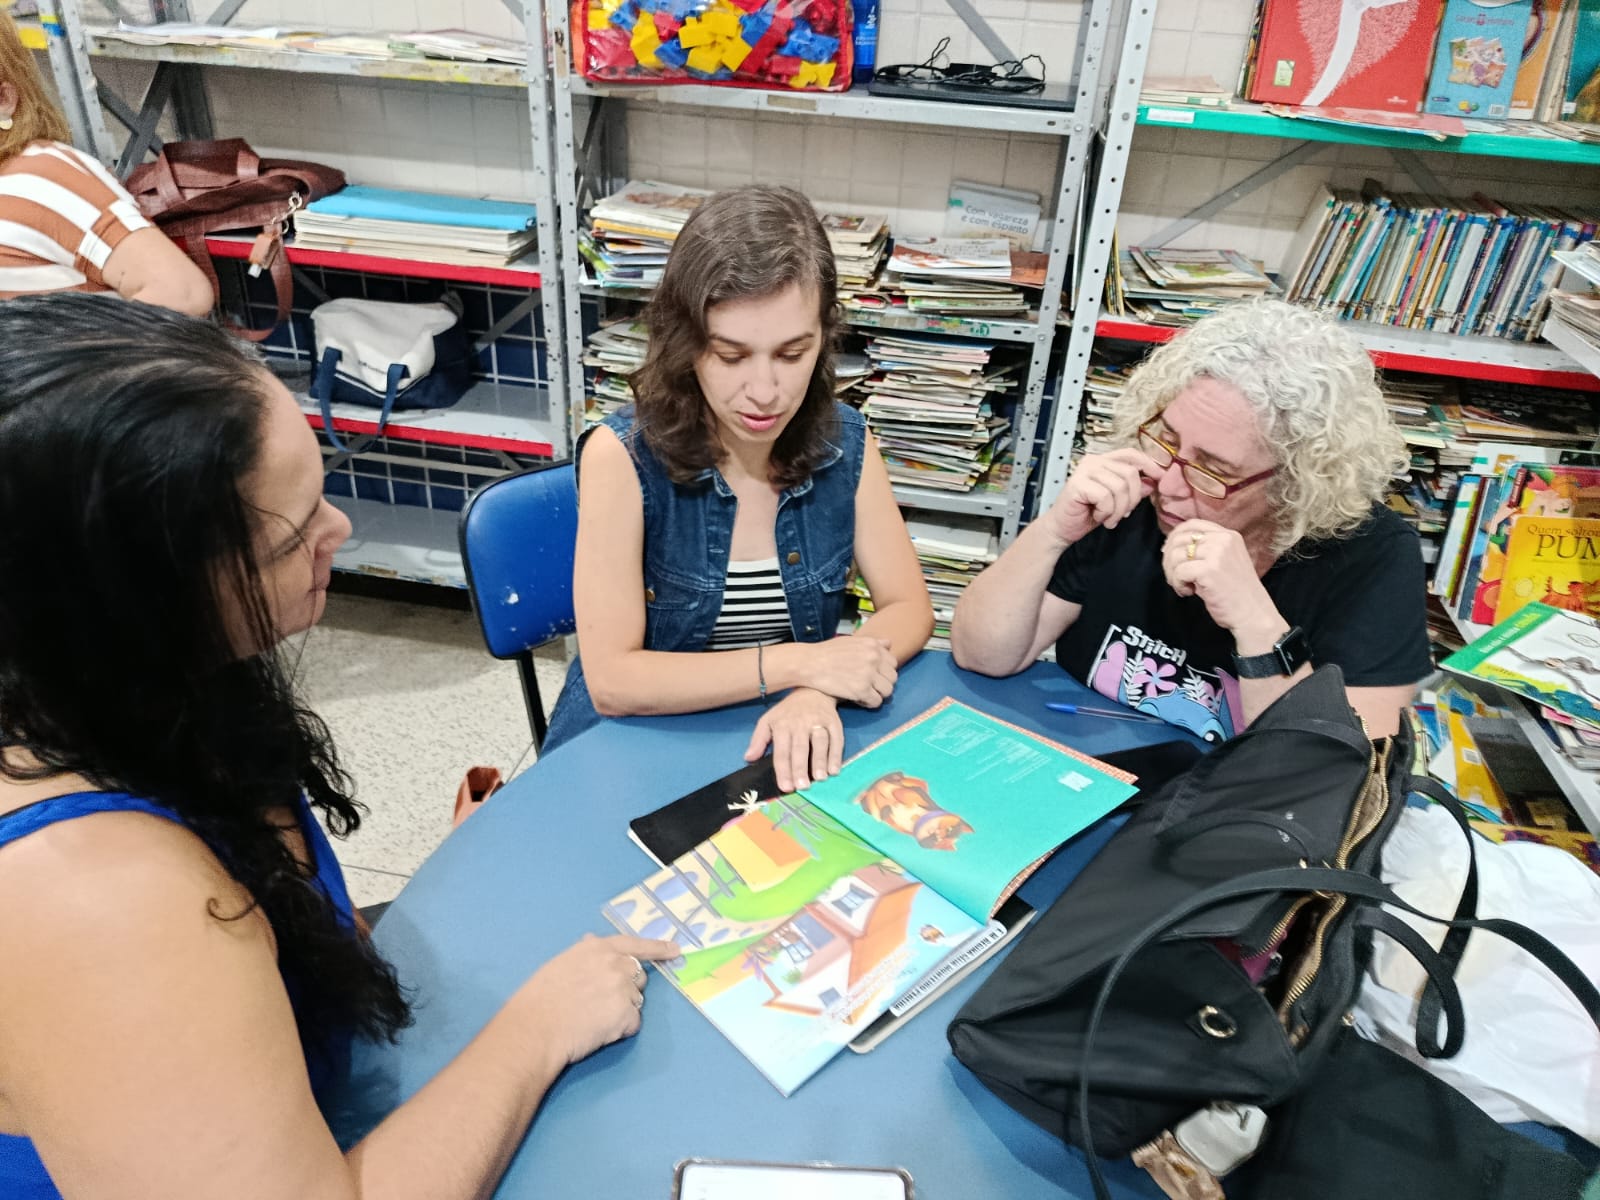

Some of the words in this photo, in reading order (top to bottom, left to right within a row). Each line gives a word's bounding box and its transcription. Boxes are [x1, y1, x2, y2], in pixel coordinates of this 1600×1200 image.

[965, 205, 986, 216] Com
[969, 216, 990, 227] com
[991, 221, 1029, 234] espanto
[1527, 523, 1562, 536] Quem
